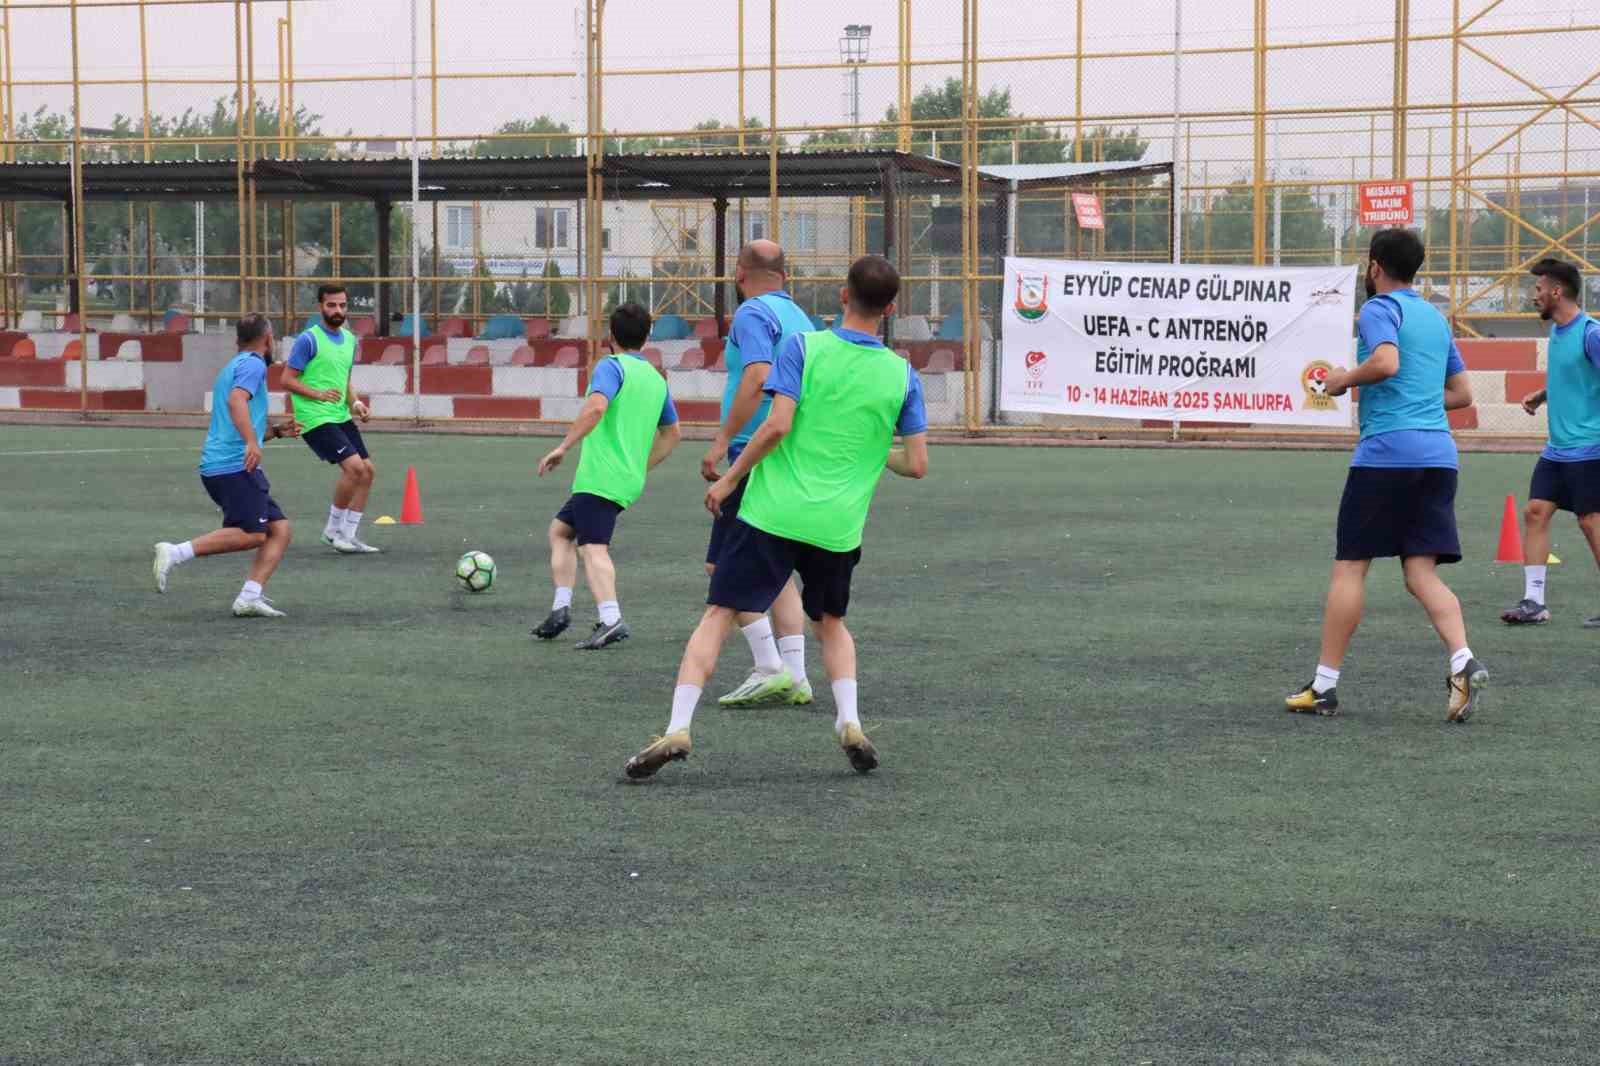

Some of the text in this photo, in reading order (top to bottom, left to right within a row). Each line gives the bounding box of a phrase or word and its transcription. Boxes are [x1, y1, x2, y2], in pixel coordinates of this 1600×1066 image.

[1063, 270, 1292, 303] EYYÜP CENAP GÜLPINAR
[1084, 314, 1131, 337] UEFA
[1148, 316, 1160, 338] C
[1165, 314, 1268, 343] ANTRENÖR
[1095, 346, 1256, 378] EĞİTİM PROĞRAMI
[1067, 385, 1081, 402] 10
[1093, 387, 1106, 404] 14
[1110, 386, 1168, 408] HAZİRAN
[1174, 391, 1209, 409] 2025
[1214, 391, 1293, 412] ŞANLIURFA
